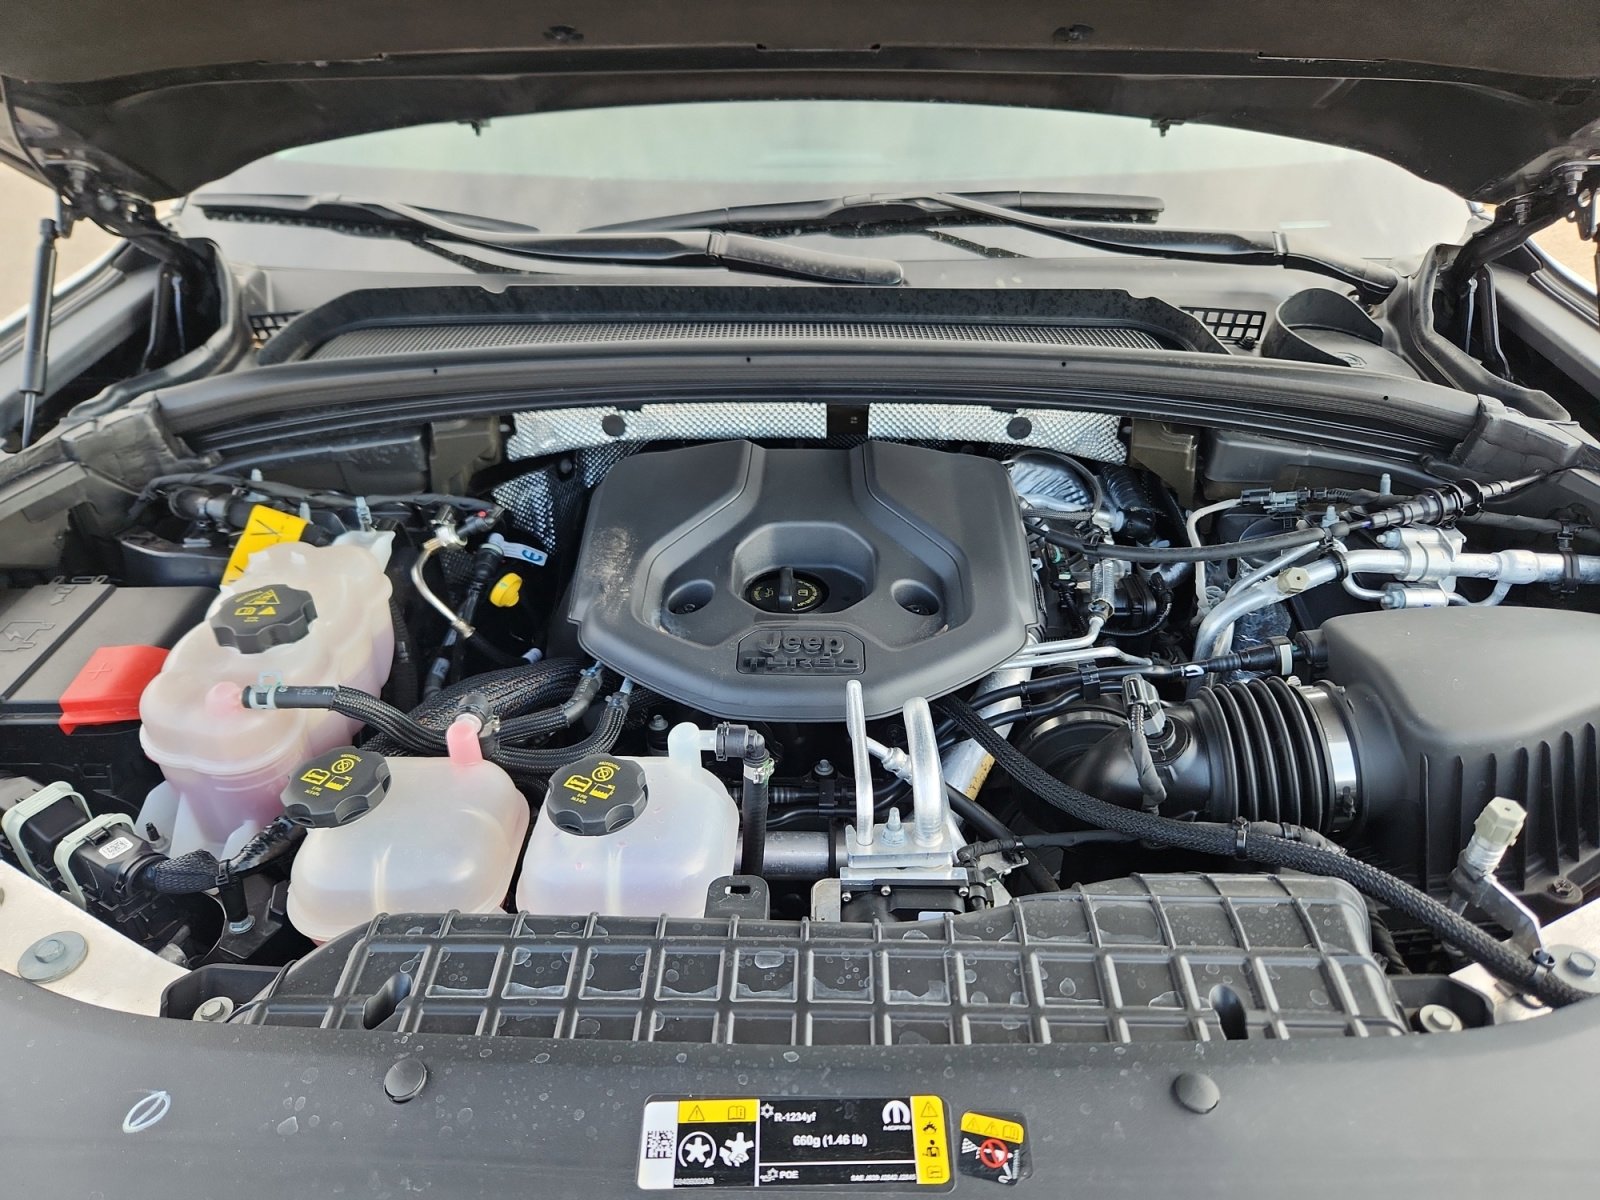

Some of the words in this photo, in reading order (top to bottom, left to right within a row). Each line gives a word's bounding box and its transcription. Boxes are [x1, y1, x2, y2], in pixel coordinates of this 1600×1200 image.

[759, 629, 845, 657] Jeep
[773, 1111, 817, 1123] R-1234yf
[792, 1134, 821, 1148] 660g
[822, 1133, 850, 1148] (1.46
[851, 1133, 868, 1147] lb)
[779, 1170, 799, 1179] POE
